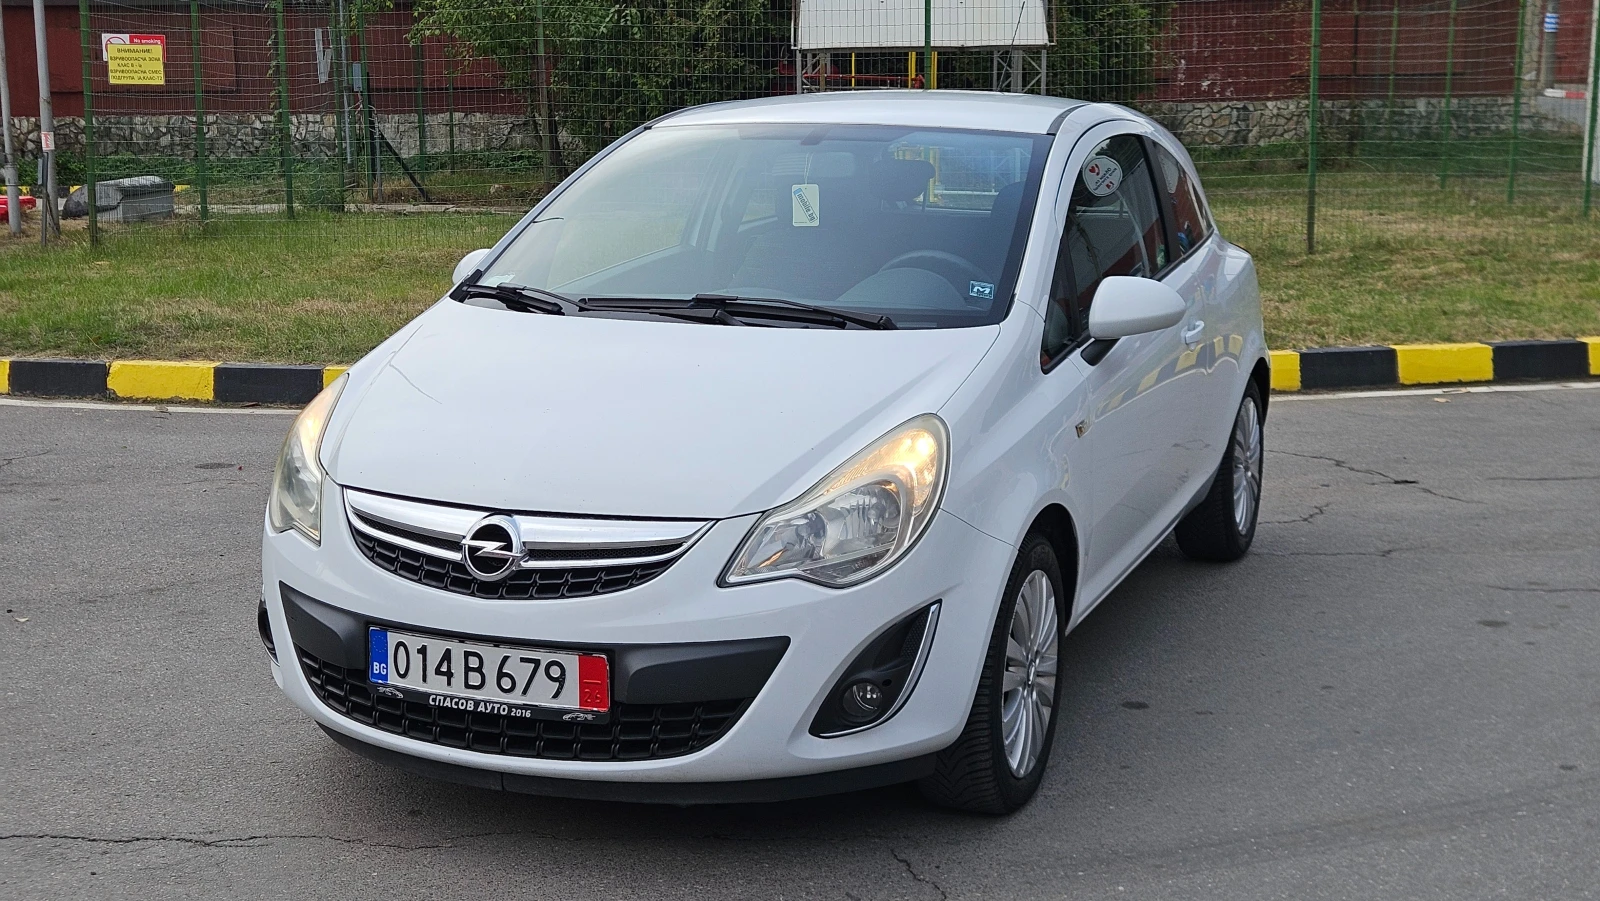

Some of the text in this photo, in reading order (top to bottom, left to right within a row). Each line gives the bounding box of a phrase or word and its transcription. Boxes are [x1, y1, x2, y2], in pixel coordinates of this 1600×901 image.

[373, 661, 387, 675] BG
[428, 694, 531, 718] СПАСОВ АУТО 2016
